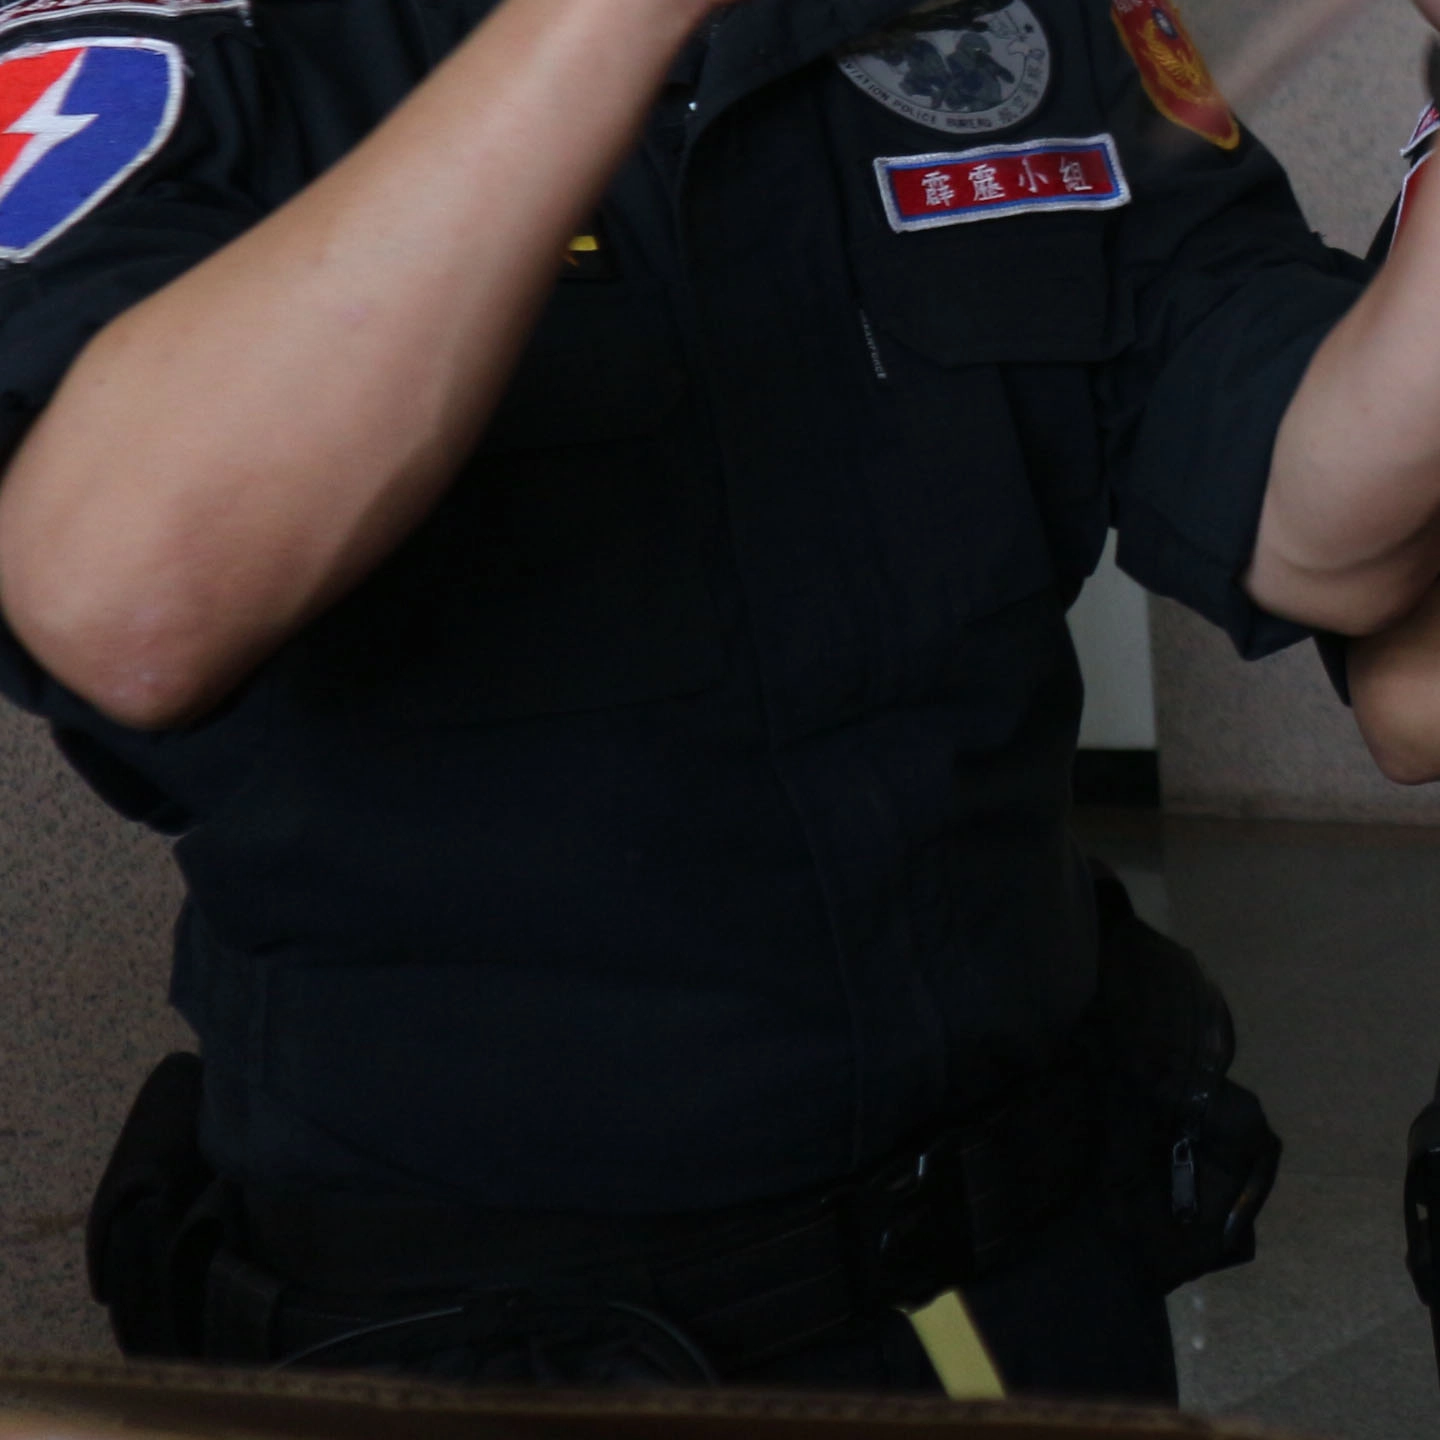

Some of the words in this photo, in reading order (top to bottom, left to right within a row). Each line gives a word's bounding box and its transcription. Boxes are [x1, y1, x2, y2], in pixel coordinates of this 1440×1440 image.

[844, 63, 891, 101] VIATION
[894, 98, 936, 125] POLICE
[920, 156, 1094, 208] 霹靂小組
